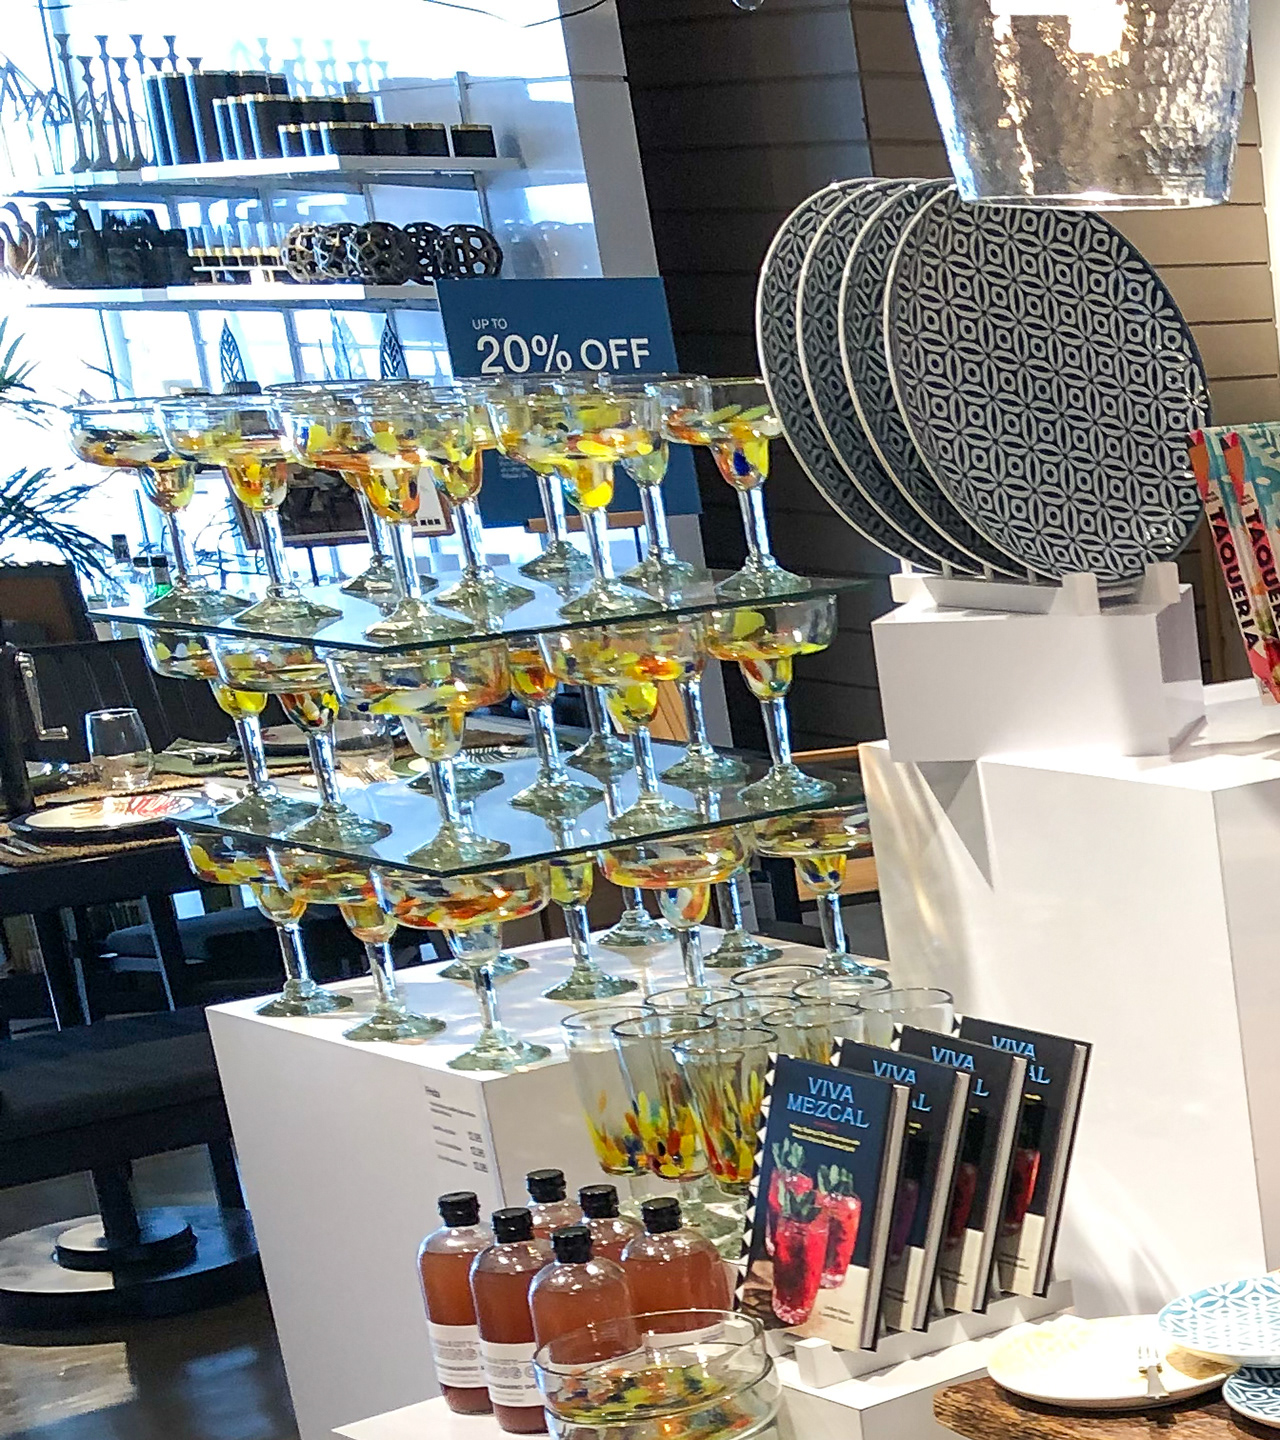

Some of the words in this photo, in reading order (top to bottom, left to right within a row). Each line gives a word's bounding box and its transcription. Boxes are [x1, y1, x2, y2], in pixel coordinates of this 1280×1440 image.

[472, 318, 491, 330] UP
[491, 318, 508, 330] TO
[477, 334, 573, 374] 20%
[580, 338, 650, 371] OFF
[1209, 507, 1261, 649] TAQUERIA
[931, 1046, 976, 1072] VIVA
[992, 1036, 1037, 1062] VIVA
[873, 1060, 916, 1085] VIVA
[808, 1076, 854, 1104] VIVA
[787, 1093, 870, 1128] MEZCAL
